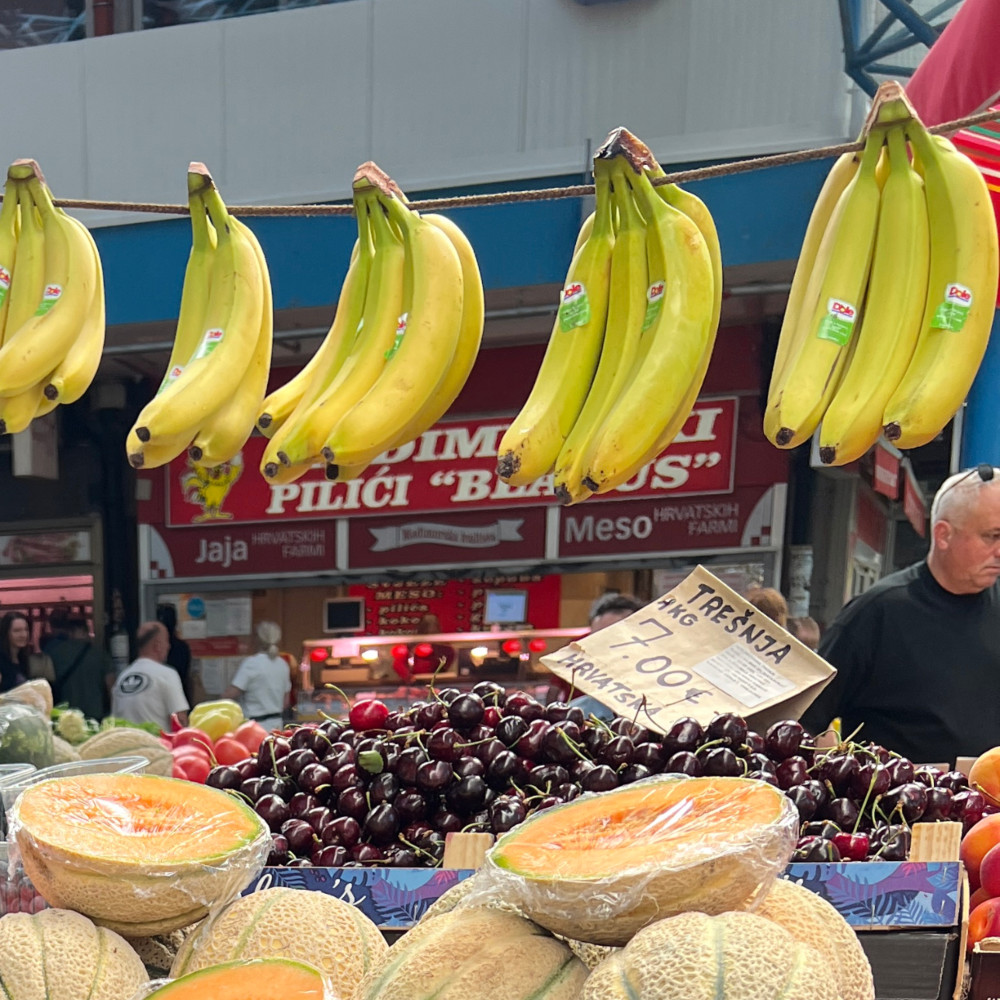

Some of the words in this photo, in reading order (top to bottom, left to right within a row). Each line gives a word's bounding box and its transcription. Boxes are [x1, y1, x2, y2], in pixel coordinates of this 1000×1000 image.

[949, 286, 971, 300] Dole
[832, 302, 854, 316] Dole
[265, 465, 413, 514] PILIĆI
[653, 502, 739, 522] HRVATSKIH
[251, 530, 326, 545] HRVATSKIH
[564, 515, 653, 543] Meso
[688, 519, 738, 536] FARMI
[195, 537, 249, 568] Jaja
[282, 541, 326, 558] FARMI
[375, 589, 443, 600] MESO:
[657, 596, 699, 628] 1KG
[692, 583, 792, 665] TREŠNJA
[556, 653, 663, 715] HRVATSKA
